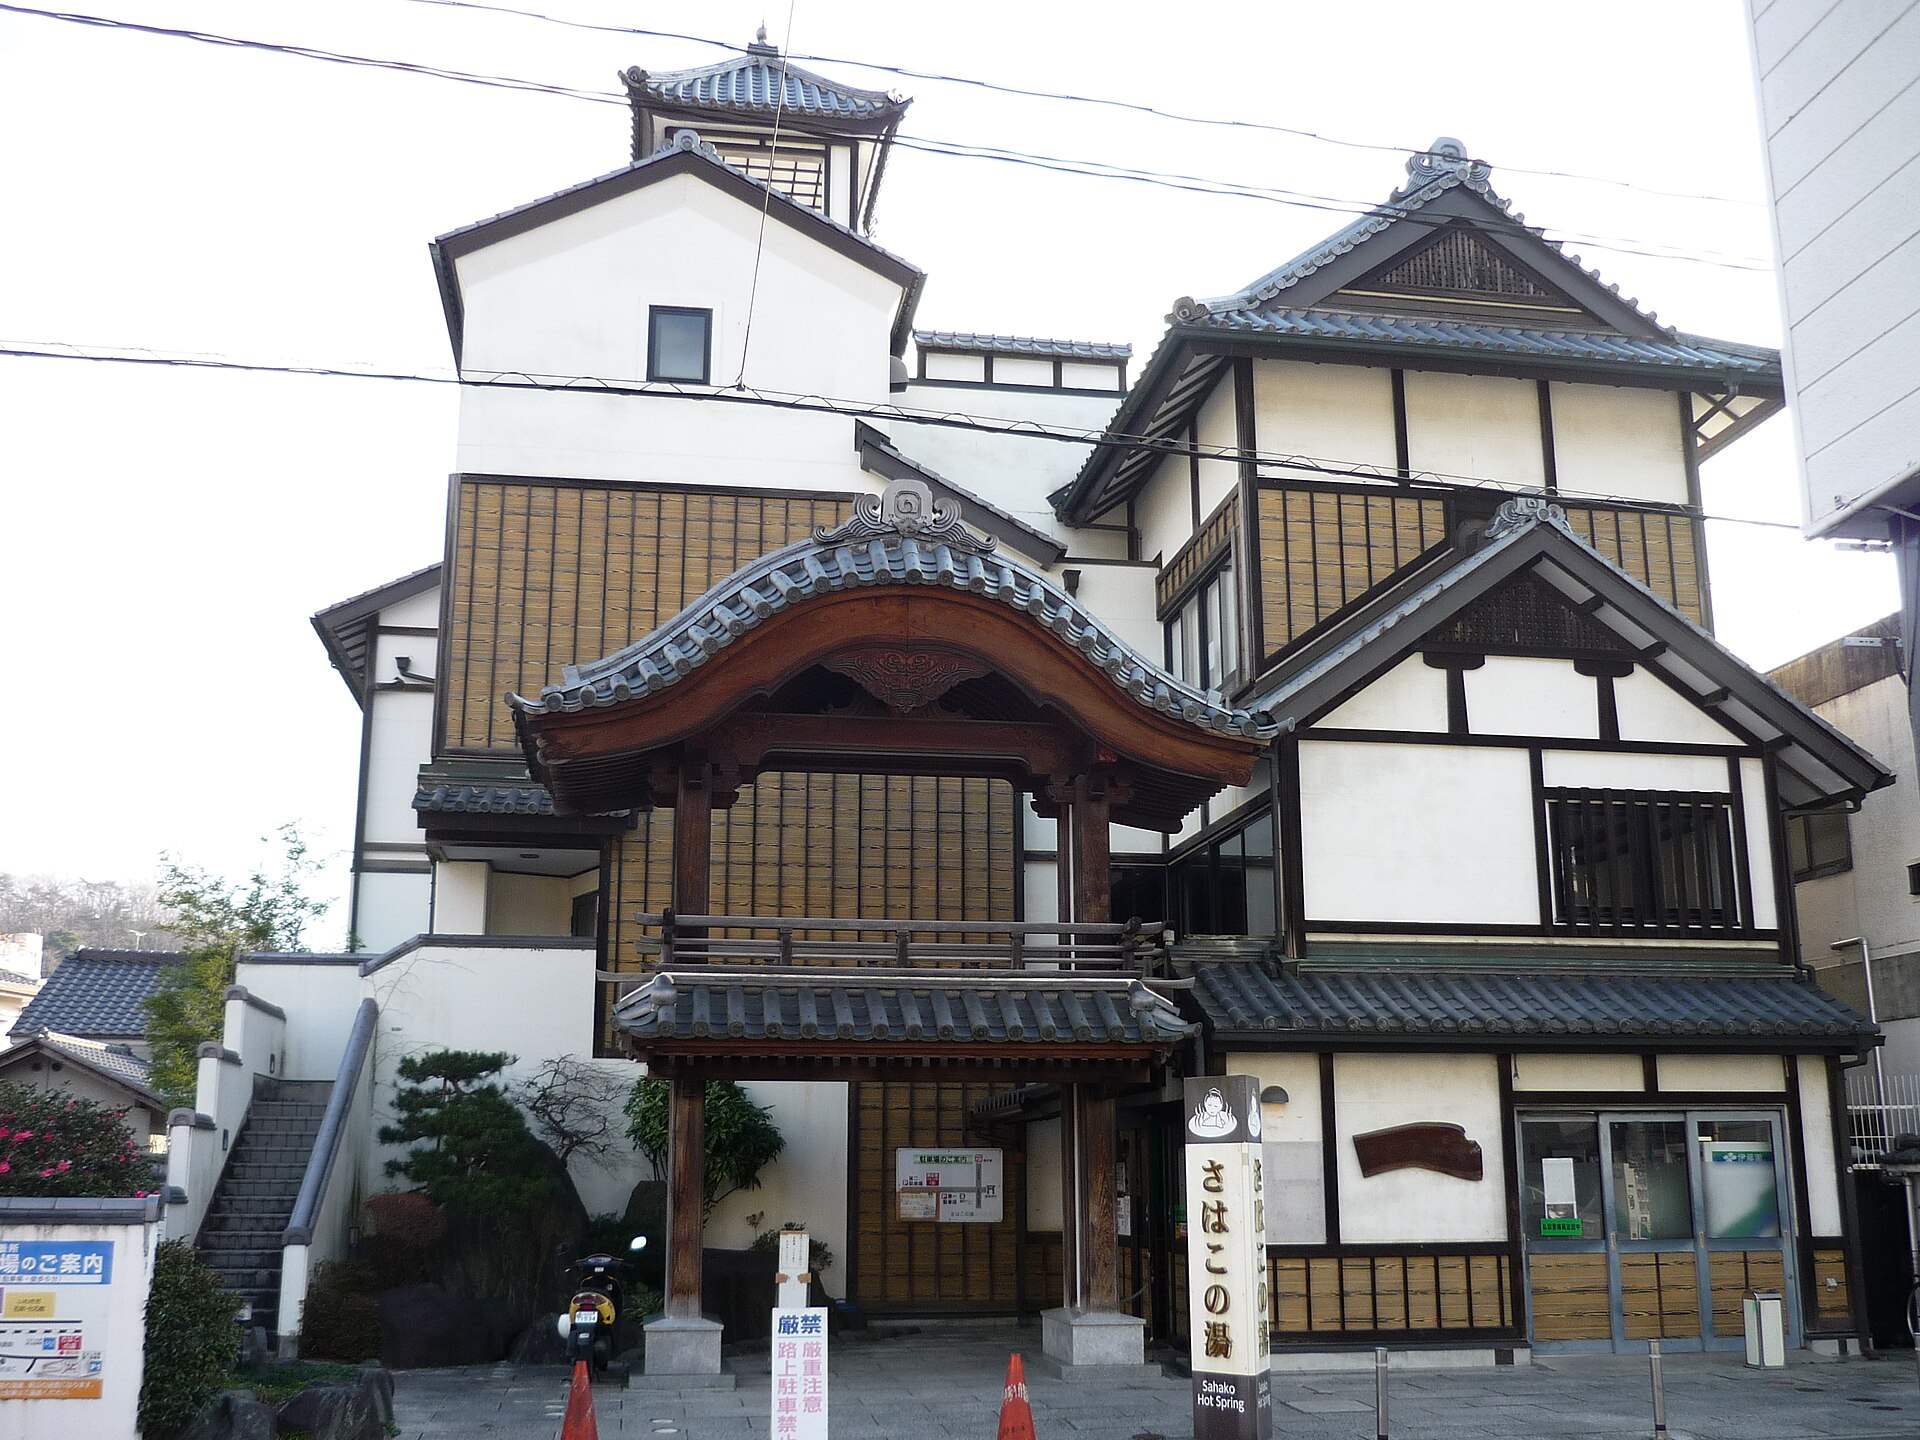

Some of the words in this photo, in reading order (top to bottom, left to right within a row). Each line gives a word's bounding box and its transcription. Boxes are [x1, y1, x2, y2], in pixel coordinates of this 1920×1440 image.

[919, 1154, 968, 1164] 駐車場のご案内
[0, 1253, 104, 1274] 場のご案内
[1201, 1158, 1233, 1360] さはこの湯
[778, 1314, 822, 1335] 厳禁
[802, 1341, 822, 1413] 厳重注意
[1202, 1379, 1236, 1395] Sahako
[1197, 1393, 1214, 1407] Hot
[1215, 1395, 1245, 1413] Spring
